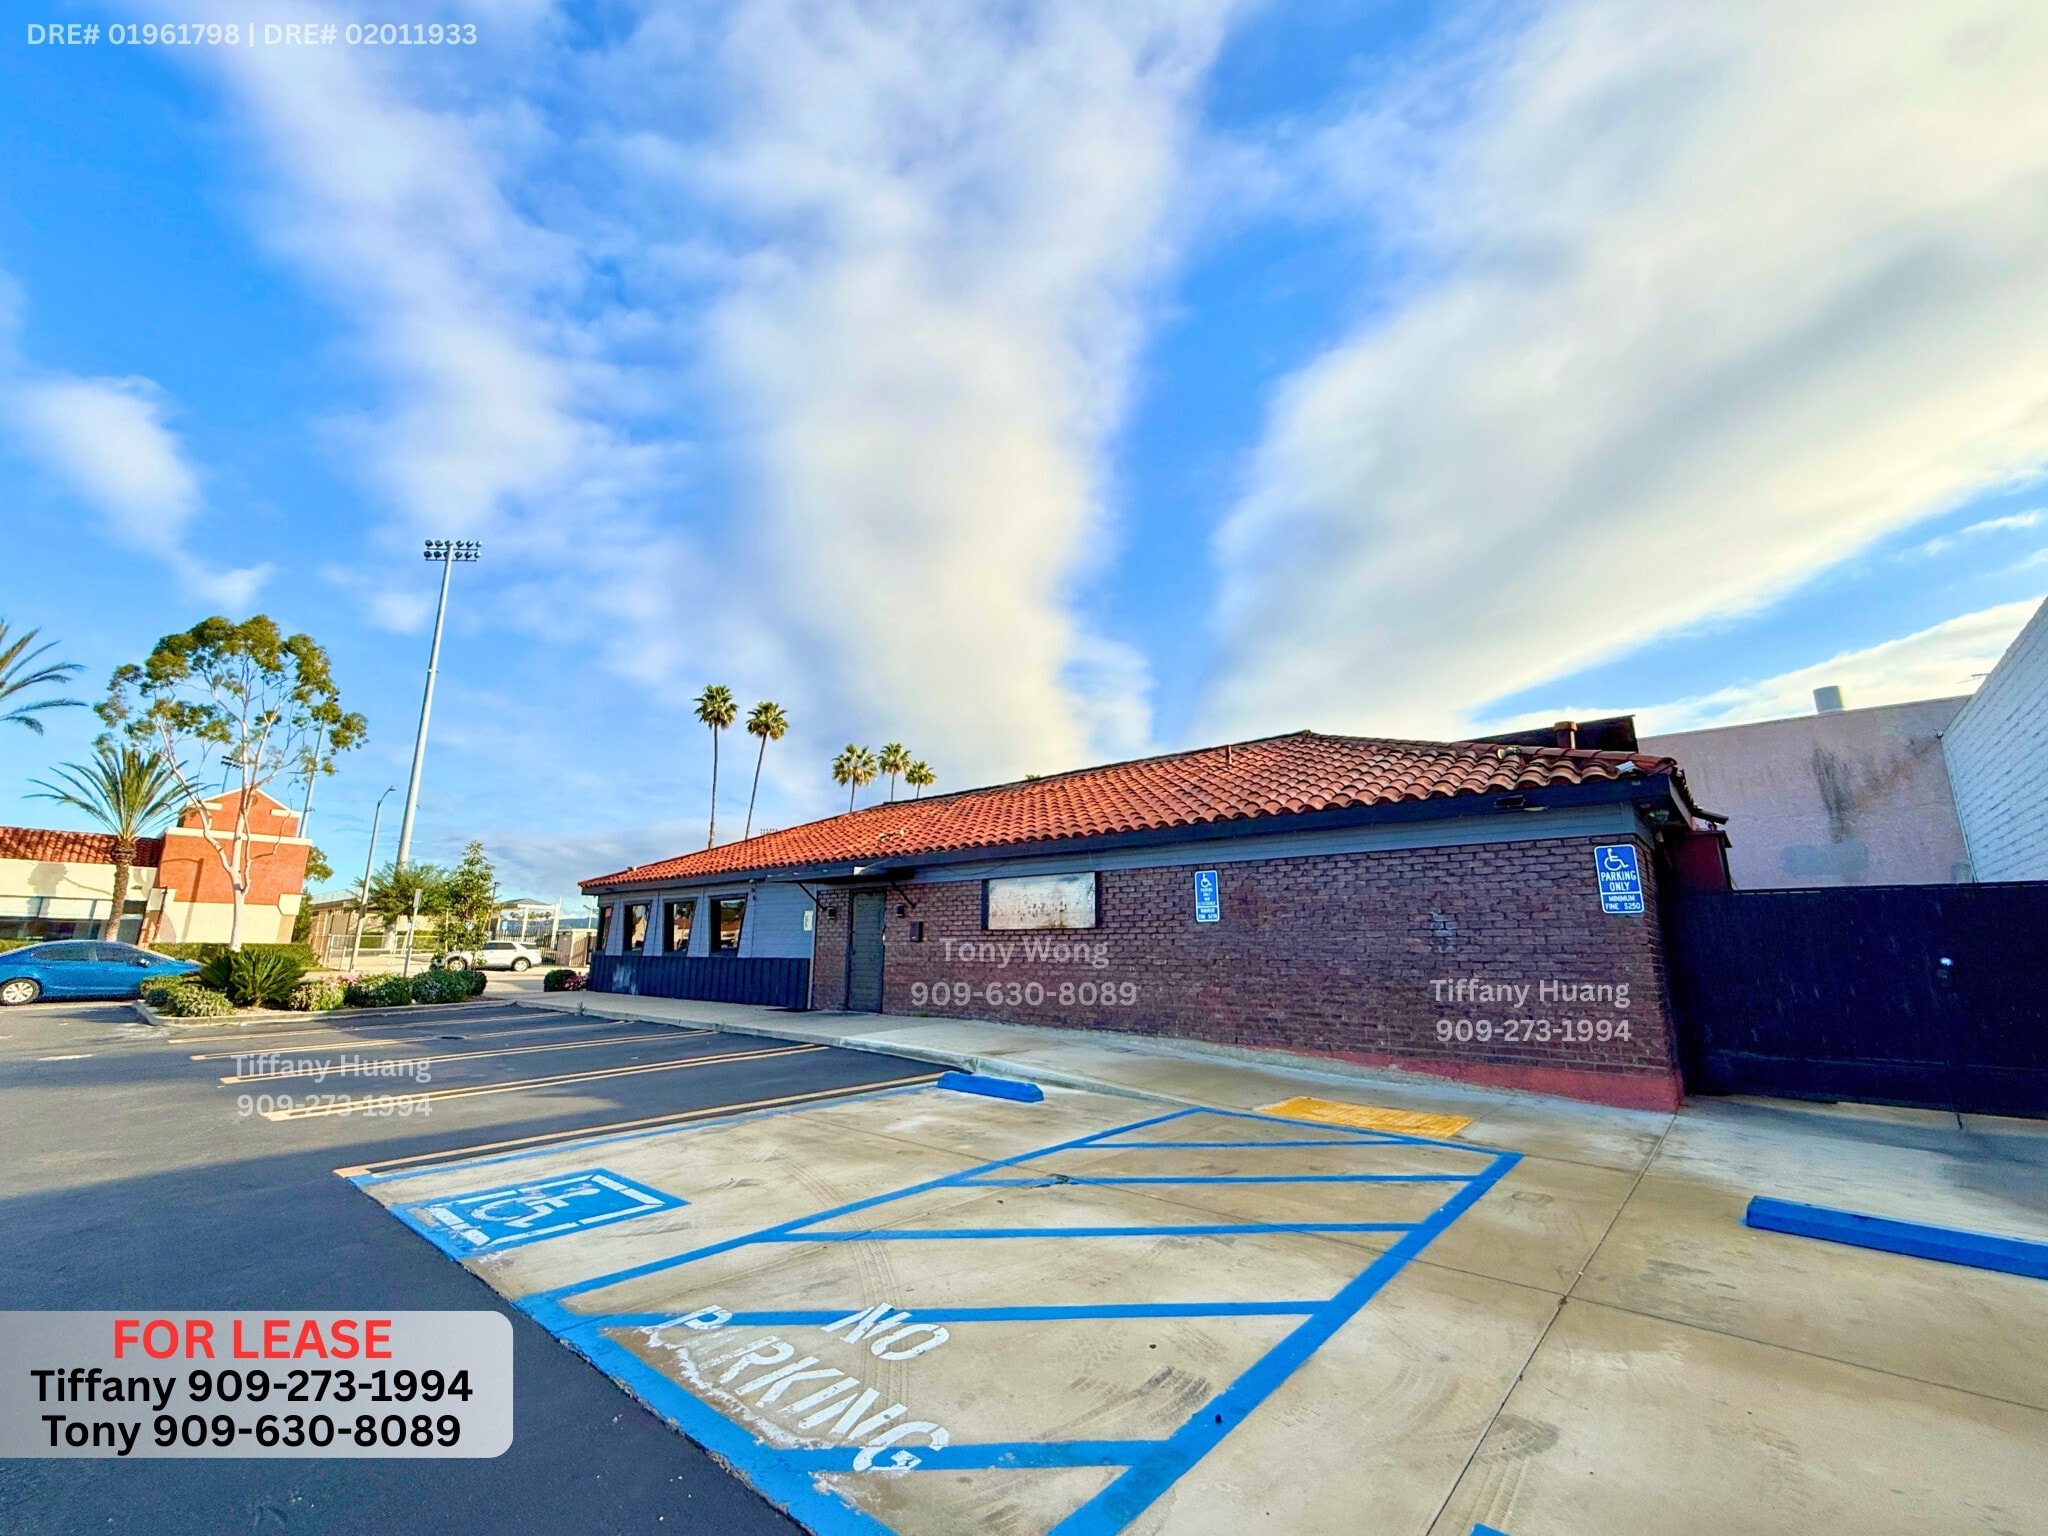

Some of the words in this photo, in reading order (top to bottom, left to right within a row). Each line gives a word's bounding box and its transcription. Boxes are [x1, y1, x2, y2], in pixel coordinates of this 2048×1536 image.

[1601, 871, 1636, 881] PARKING
[1610, 882, 1629, 891] ONLY
[821, 1302, 950, 1361] NO
[637, 1304, 950, 1472] PARKING
